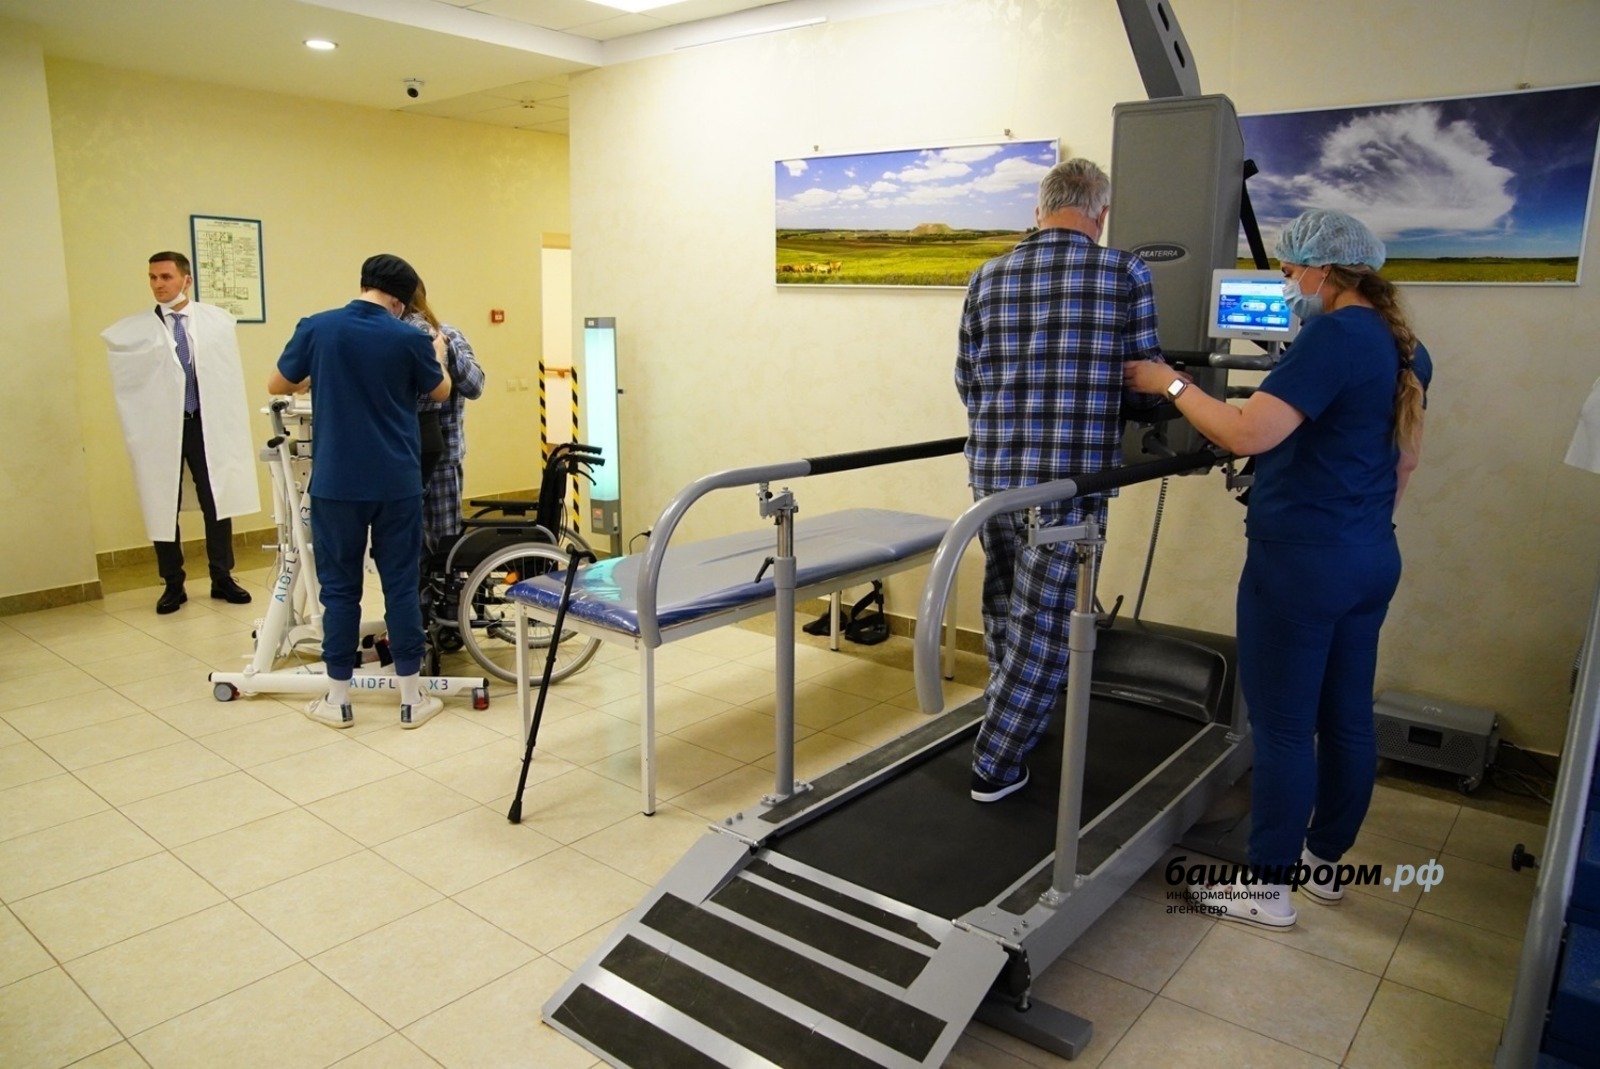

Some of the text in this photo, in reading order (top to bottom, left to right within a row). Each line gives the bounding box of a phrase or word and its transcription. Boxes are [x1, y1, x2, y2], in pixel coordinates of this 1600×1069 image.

[1140, 250, 1178, 258] REATERRA
[349, 677, 449, 690] AIDFL X3
